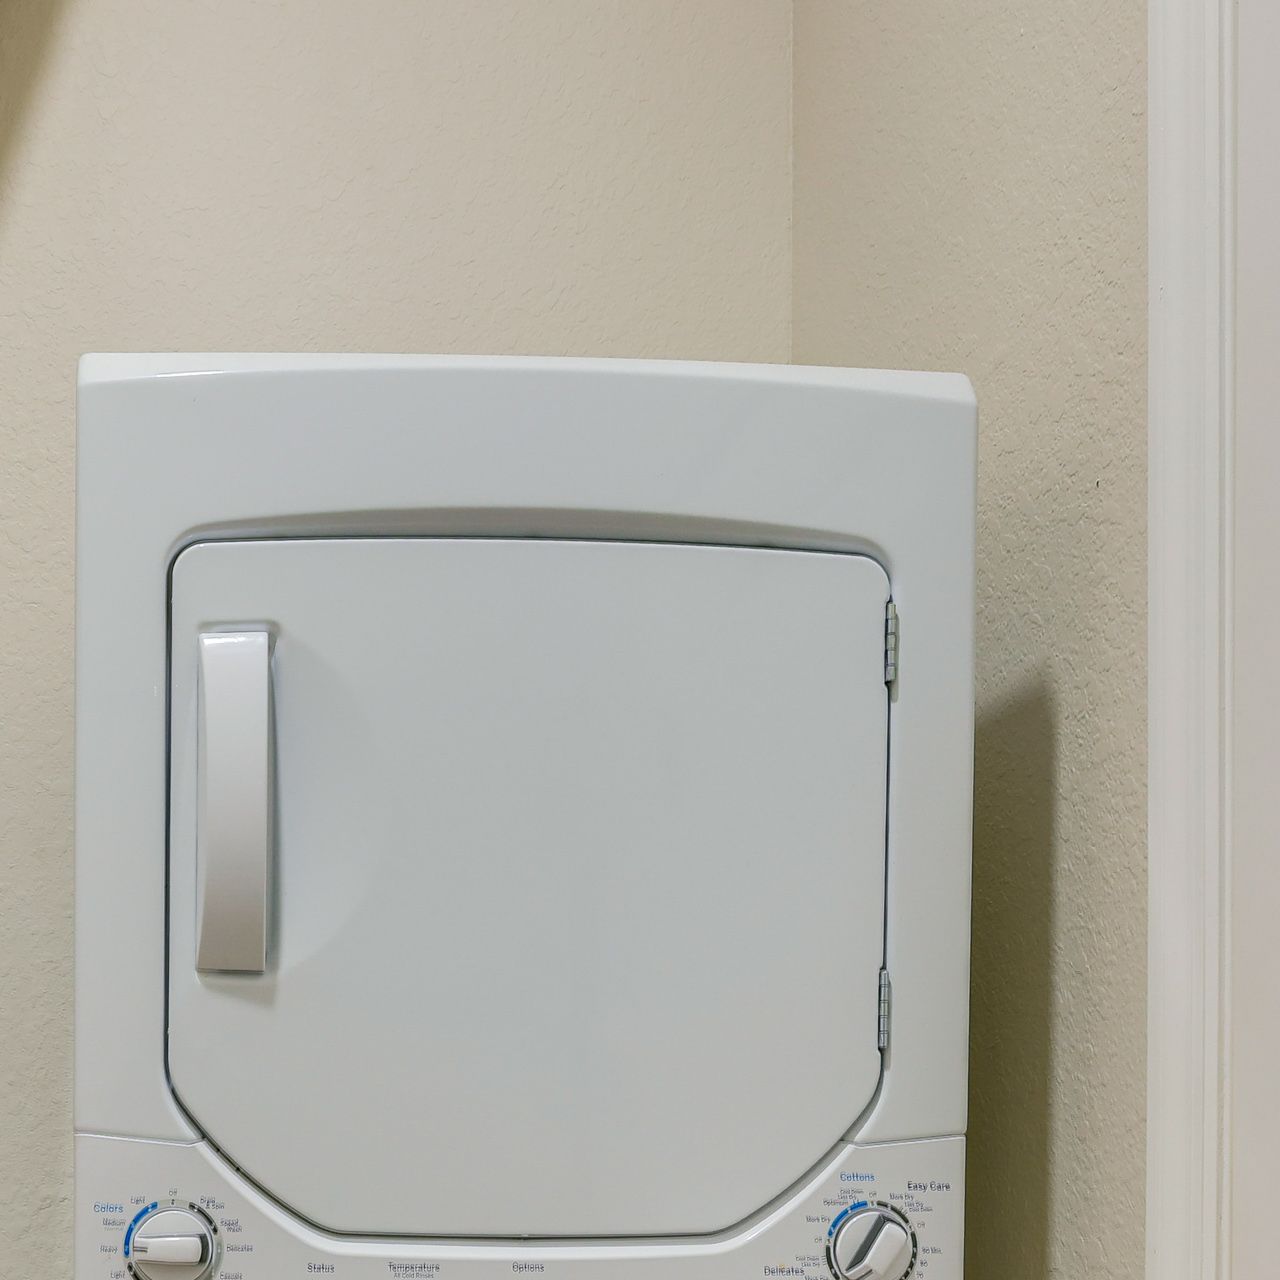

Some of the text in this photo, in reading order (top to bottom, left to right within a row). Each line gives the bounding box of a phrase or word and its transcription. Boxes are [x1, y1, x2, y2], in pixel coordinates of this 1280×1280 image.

[840, 1173, 875, 1183] Cottons
[907, 1181, 951, 1193] Easy Care
[93, 1202, 124, 1214] Colors
[307, 1262, 335, 1274] Status
[388, 1262, 440, 1273] Temperature
[512, 1262, 545, 1273] Options
[764, 1265, 805, 1277] Delicates
